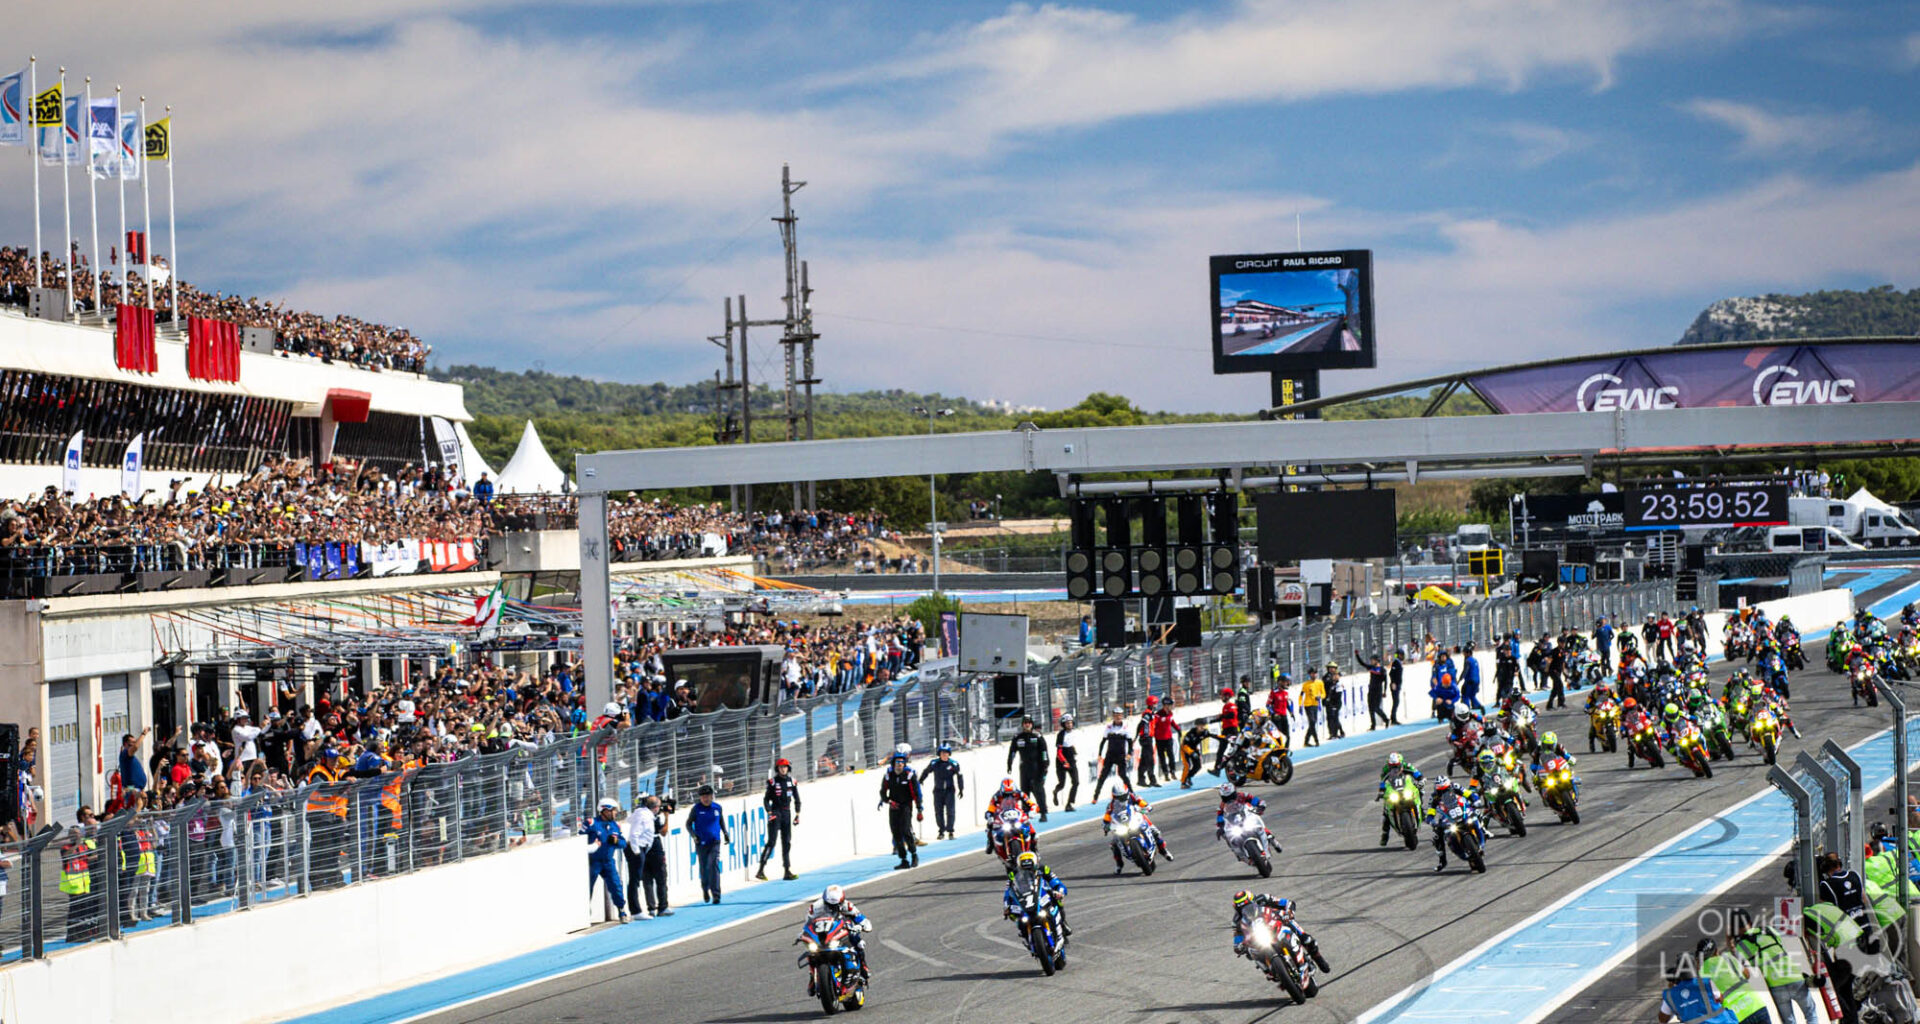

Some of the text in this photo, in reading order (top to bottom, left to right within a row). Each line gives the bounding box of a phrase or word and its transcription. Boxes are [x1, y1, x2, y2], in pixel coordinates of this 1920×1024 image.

[1235, 256, 1342, 270] CIRCUIT PAUL RICARD
[1593, 386, 1680, 411] EWC
[1769, 378, 1856, 405] EWC
[1641, 491, 1770, 521] 23:59:52
[1568, 512, 1624, 525] MOTO PARK
[1547, 760, 1556, 770] 9
[1449, 806, 1463, 819] 99
[728, 806, 775, 872] RICAR
[1024, 894, 1035, 909] 1
[814, 920, 833, 933] 37
